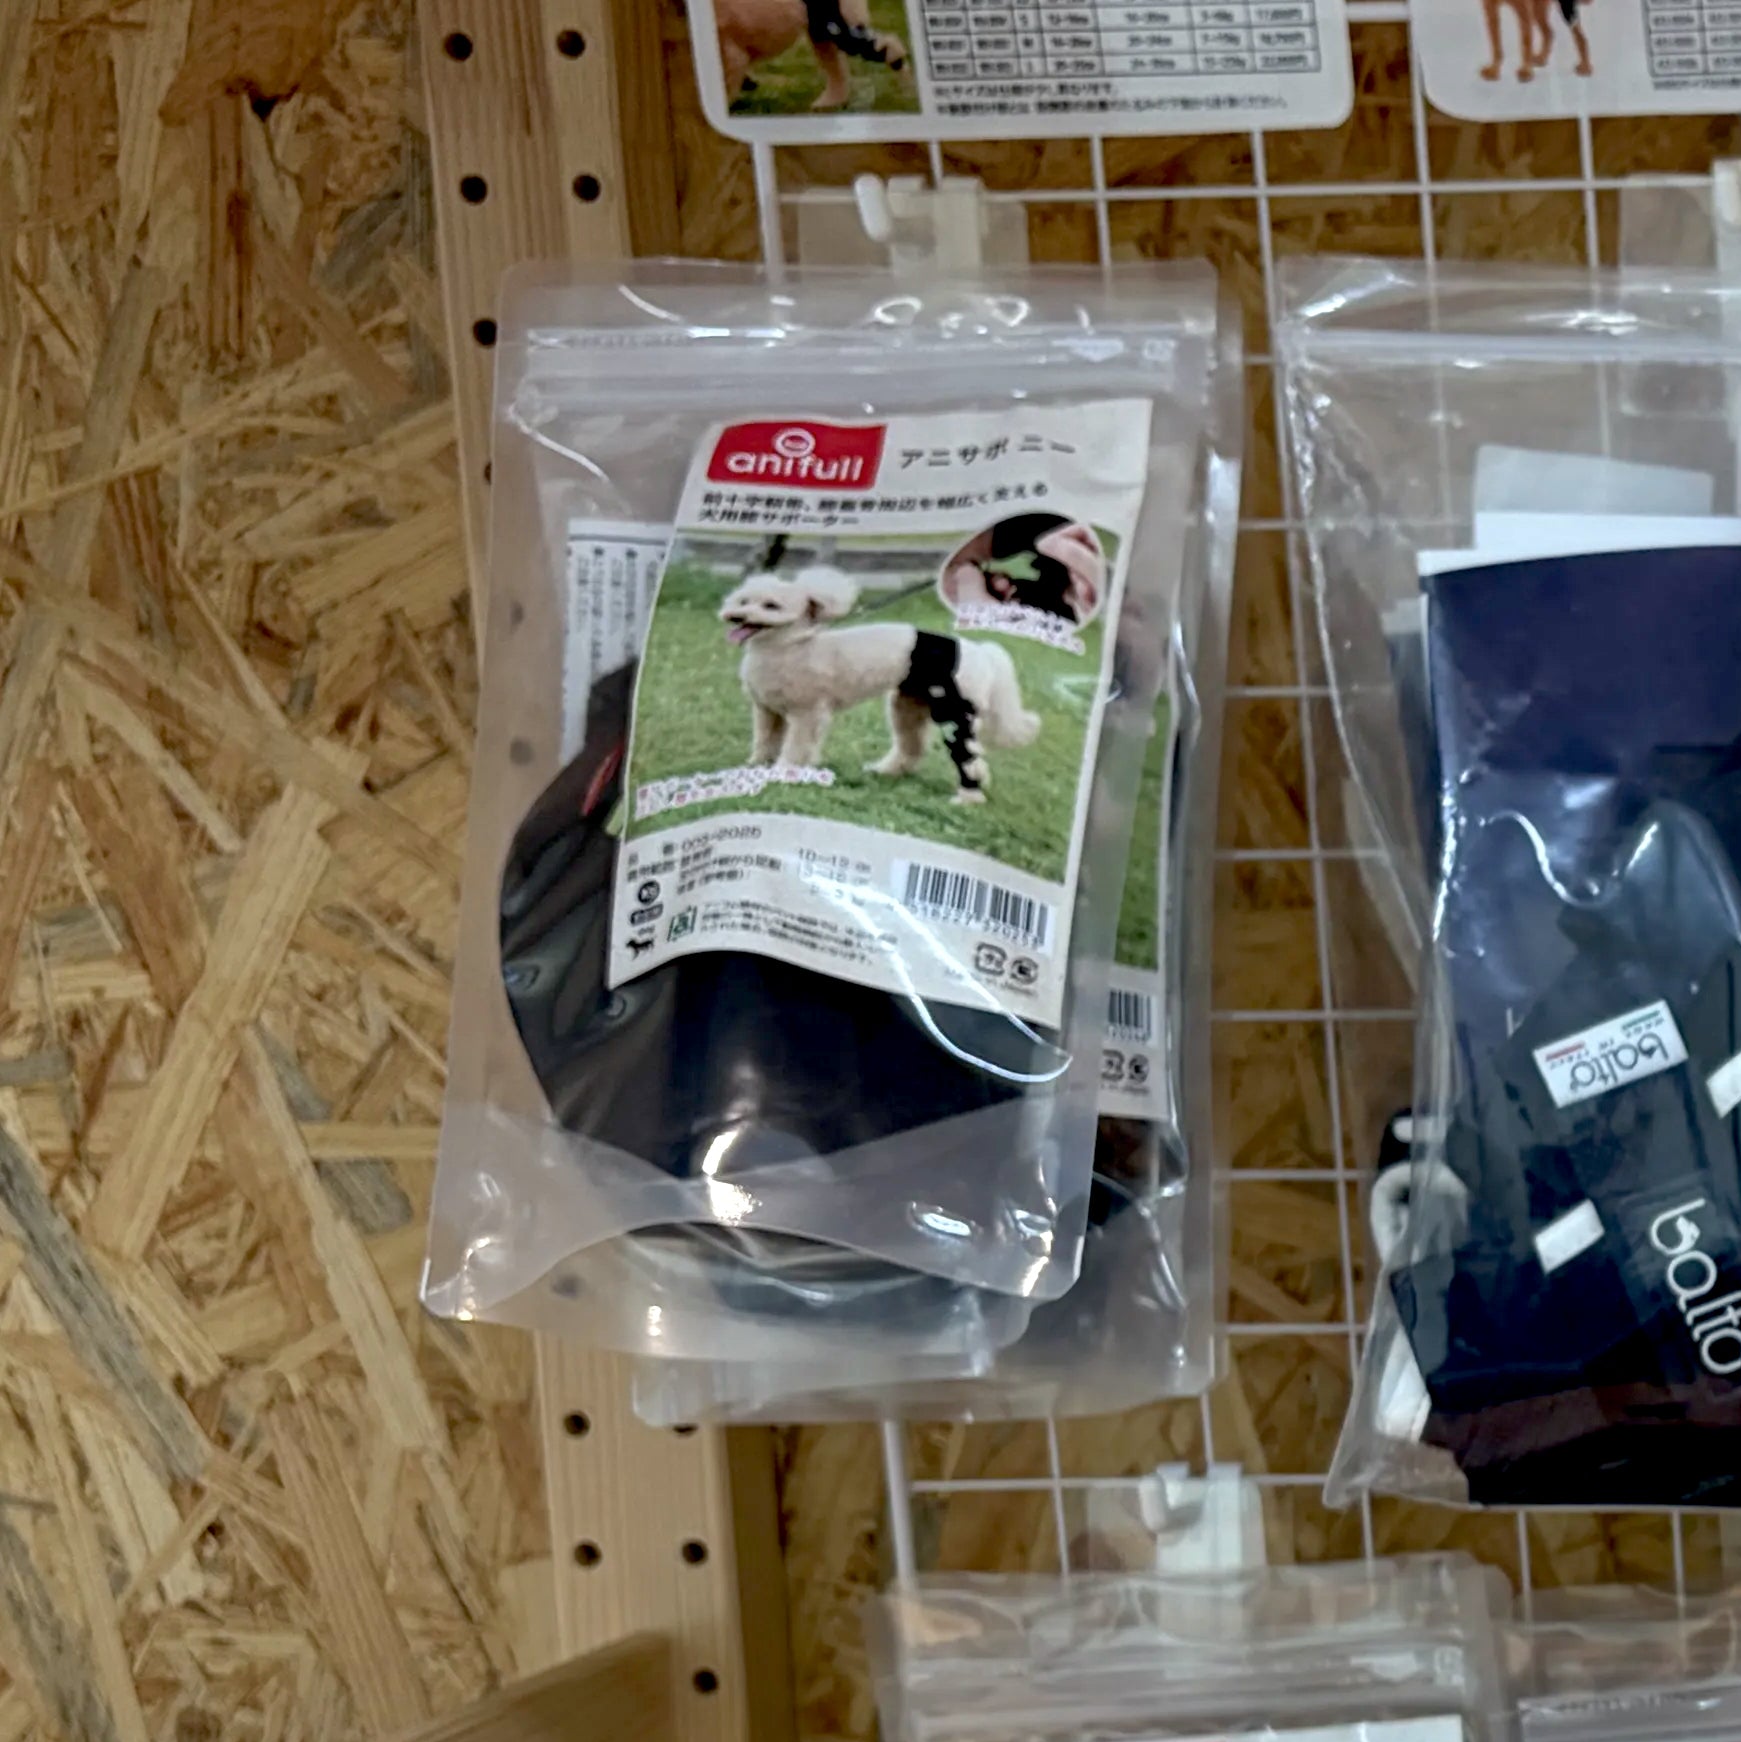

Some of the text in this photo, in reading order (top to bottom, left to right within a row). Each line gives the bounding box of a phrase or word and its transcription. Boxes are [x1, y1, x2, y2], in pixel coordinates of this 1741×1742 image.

[726, 452, 864, 481] anifull
[900, 438, 1007, 468] アニサポ
[1569, 1031, 1670, 1092] balto
